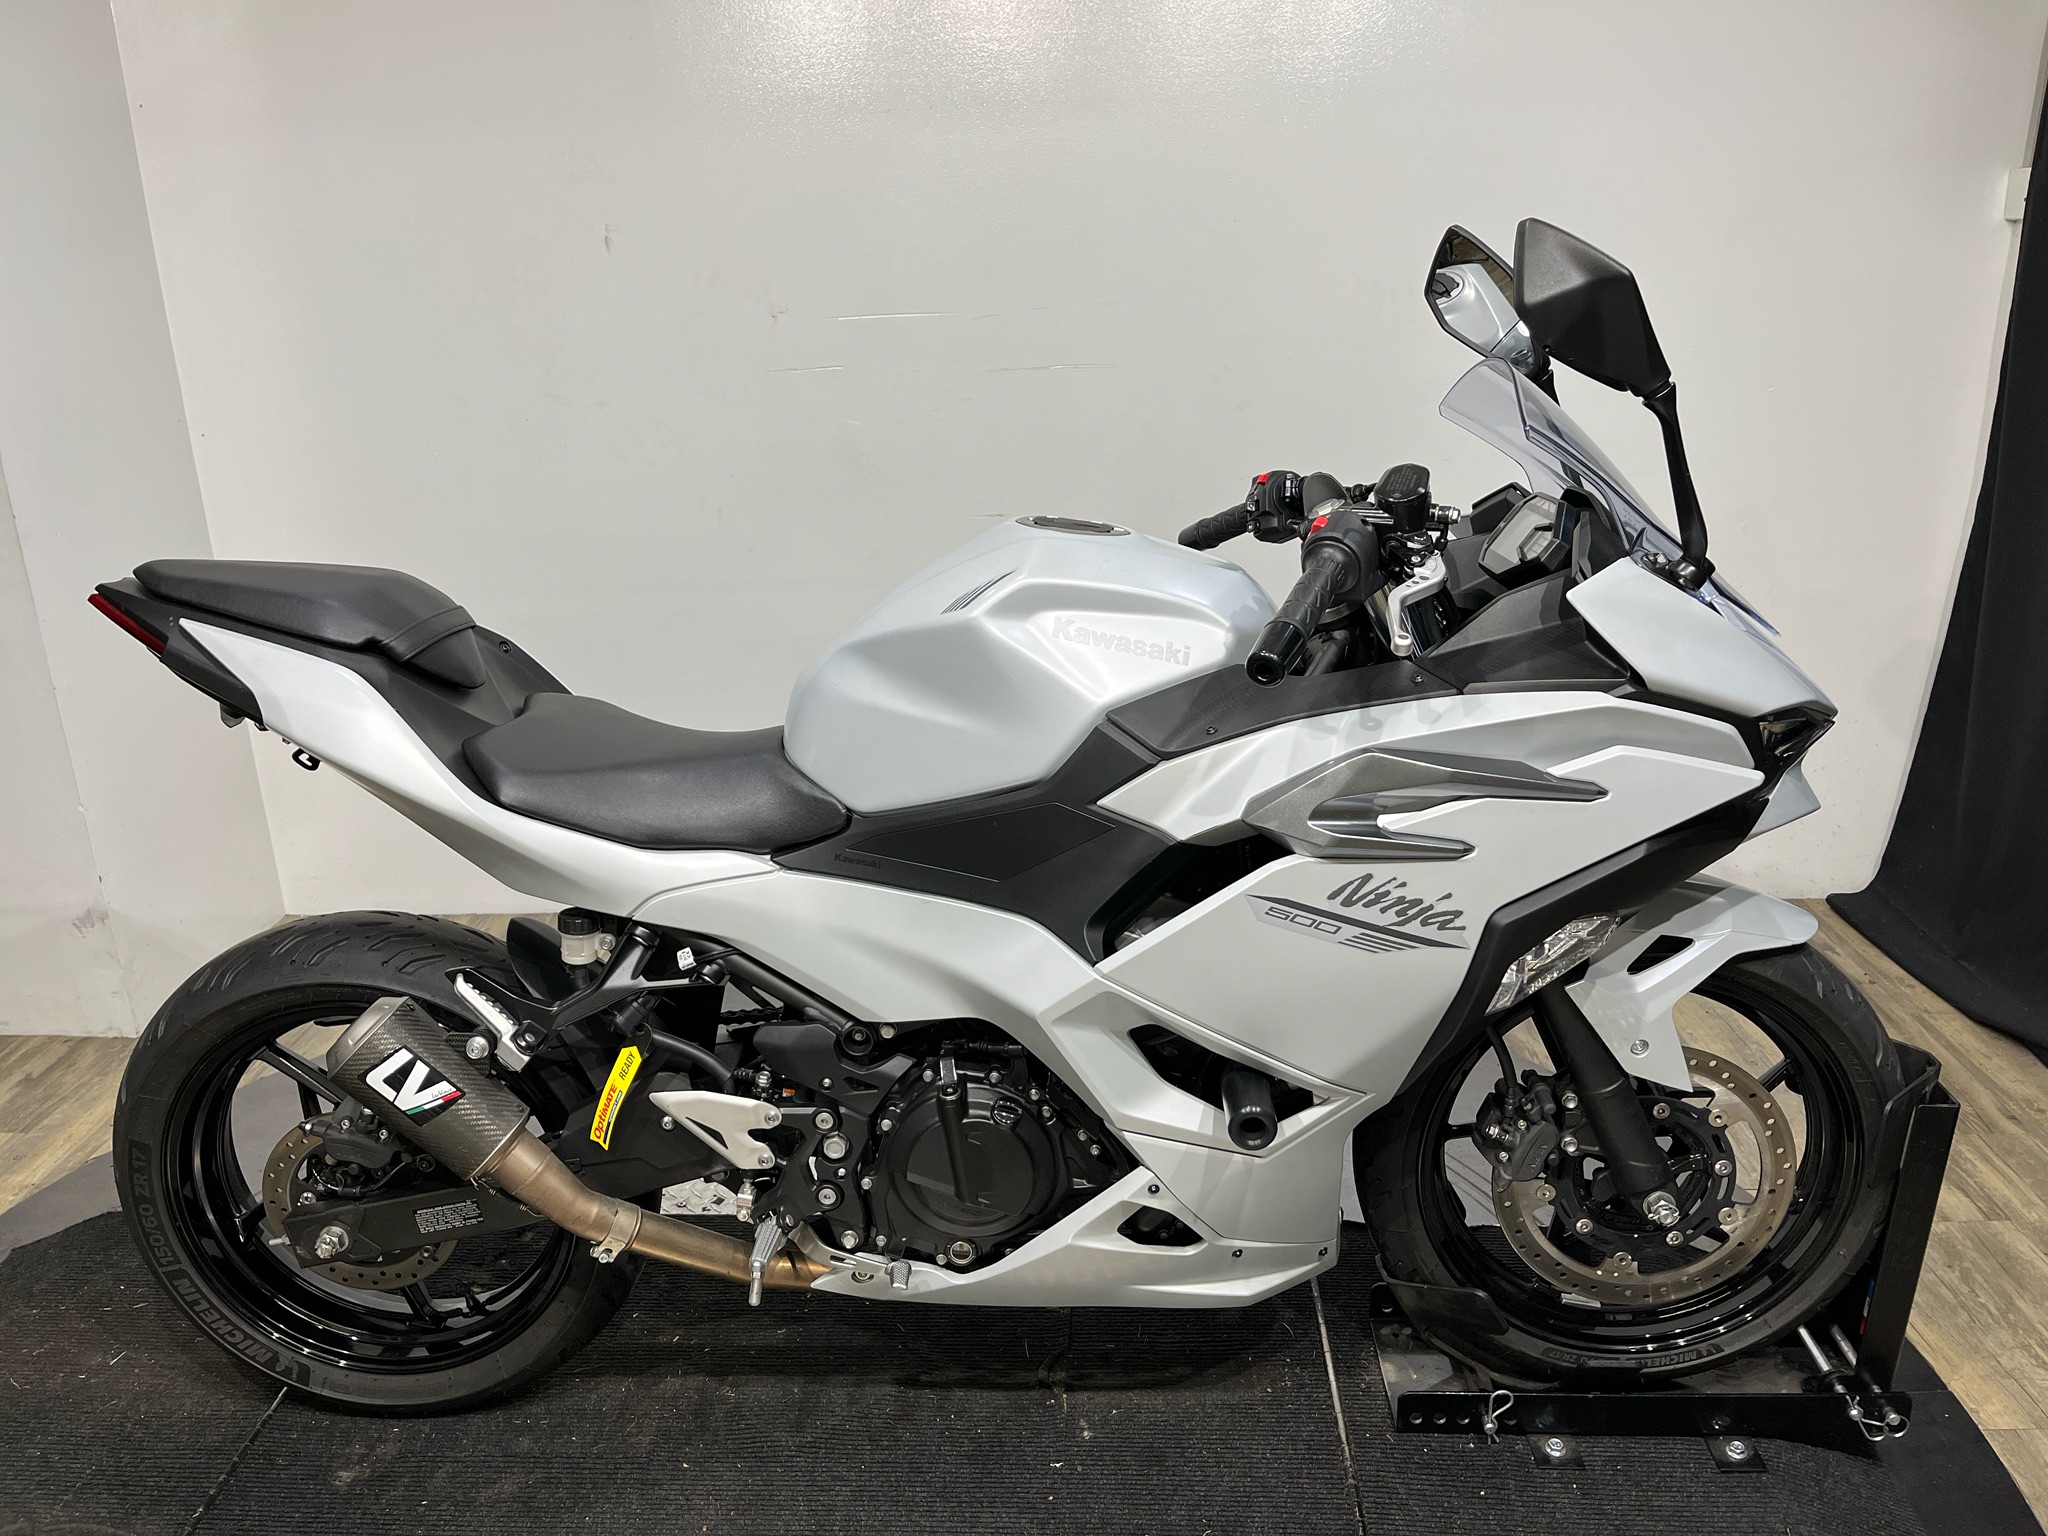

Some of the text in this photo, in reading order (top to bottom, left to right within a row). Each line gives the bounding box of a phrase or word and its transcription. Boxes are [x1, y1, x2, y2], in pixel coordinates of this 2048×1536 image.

[1052, 616, 1191, 666] Kawasaki
[833, 853, 881, 869] Kawasaki
[1264, 906, 1341, 935] 500
[1326, 872, 1467, 932] Ninja
[618, 1051, 636, 1081] READY
[132, 1147, 175, 1267] 150/60 ZR 17
[172, 1277, 274, 1364] MICHELIN
[1549, 1350, 1561, 1360] 17
